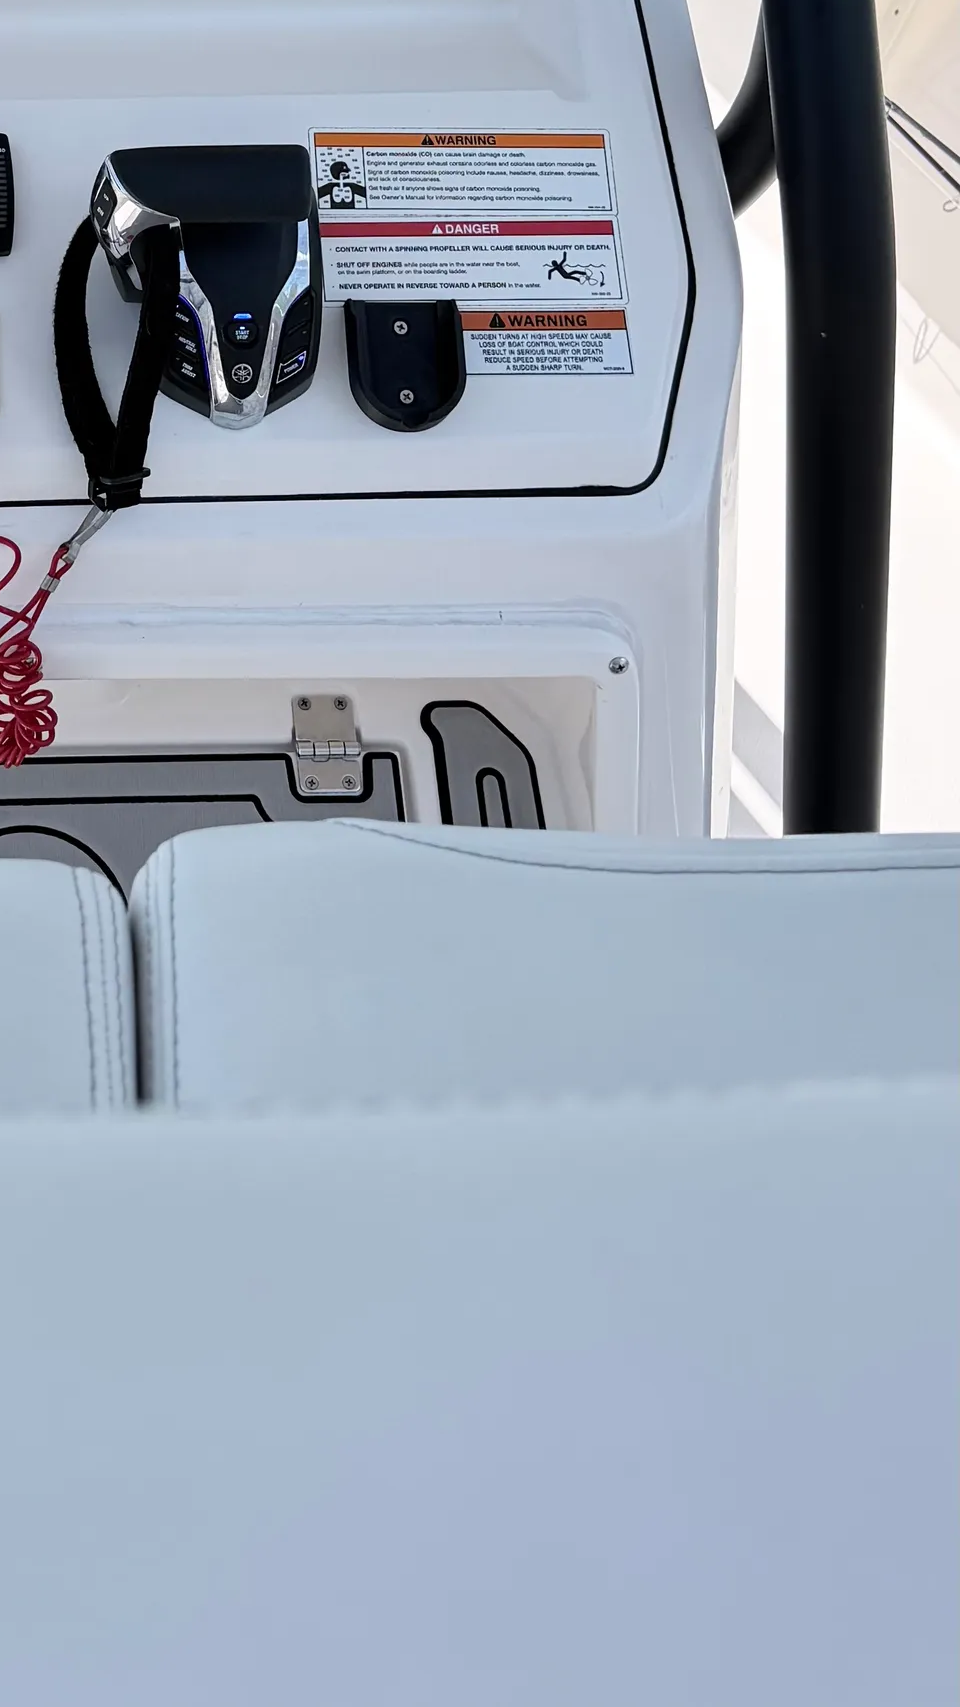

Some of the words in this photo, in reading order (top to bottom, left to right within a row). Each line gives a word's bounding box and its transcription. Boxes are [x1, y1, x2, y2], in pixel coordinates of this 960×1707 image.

[435, 136, 497, 145] WARNING
[445, 224, 499, 234] DANGER
[508, 315, 587, 326] WARNING
